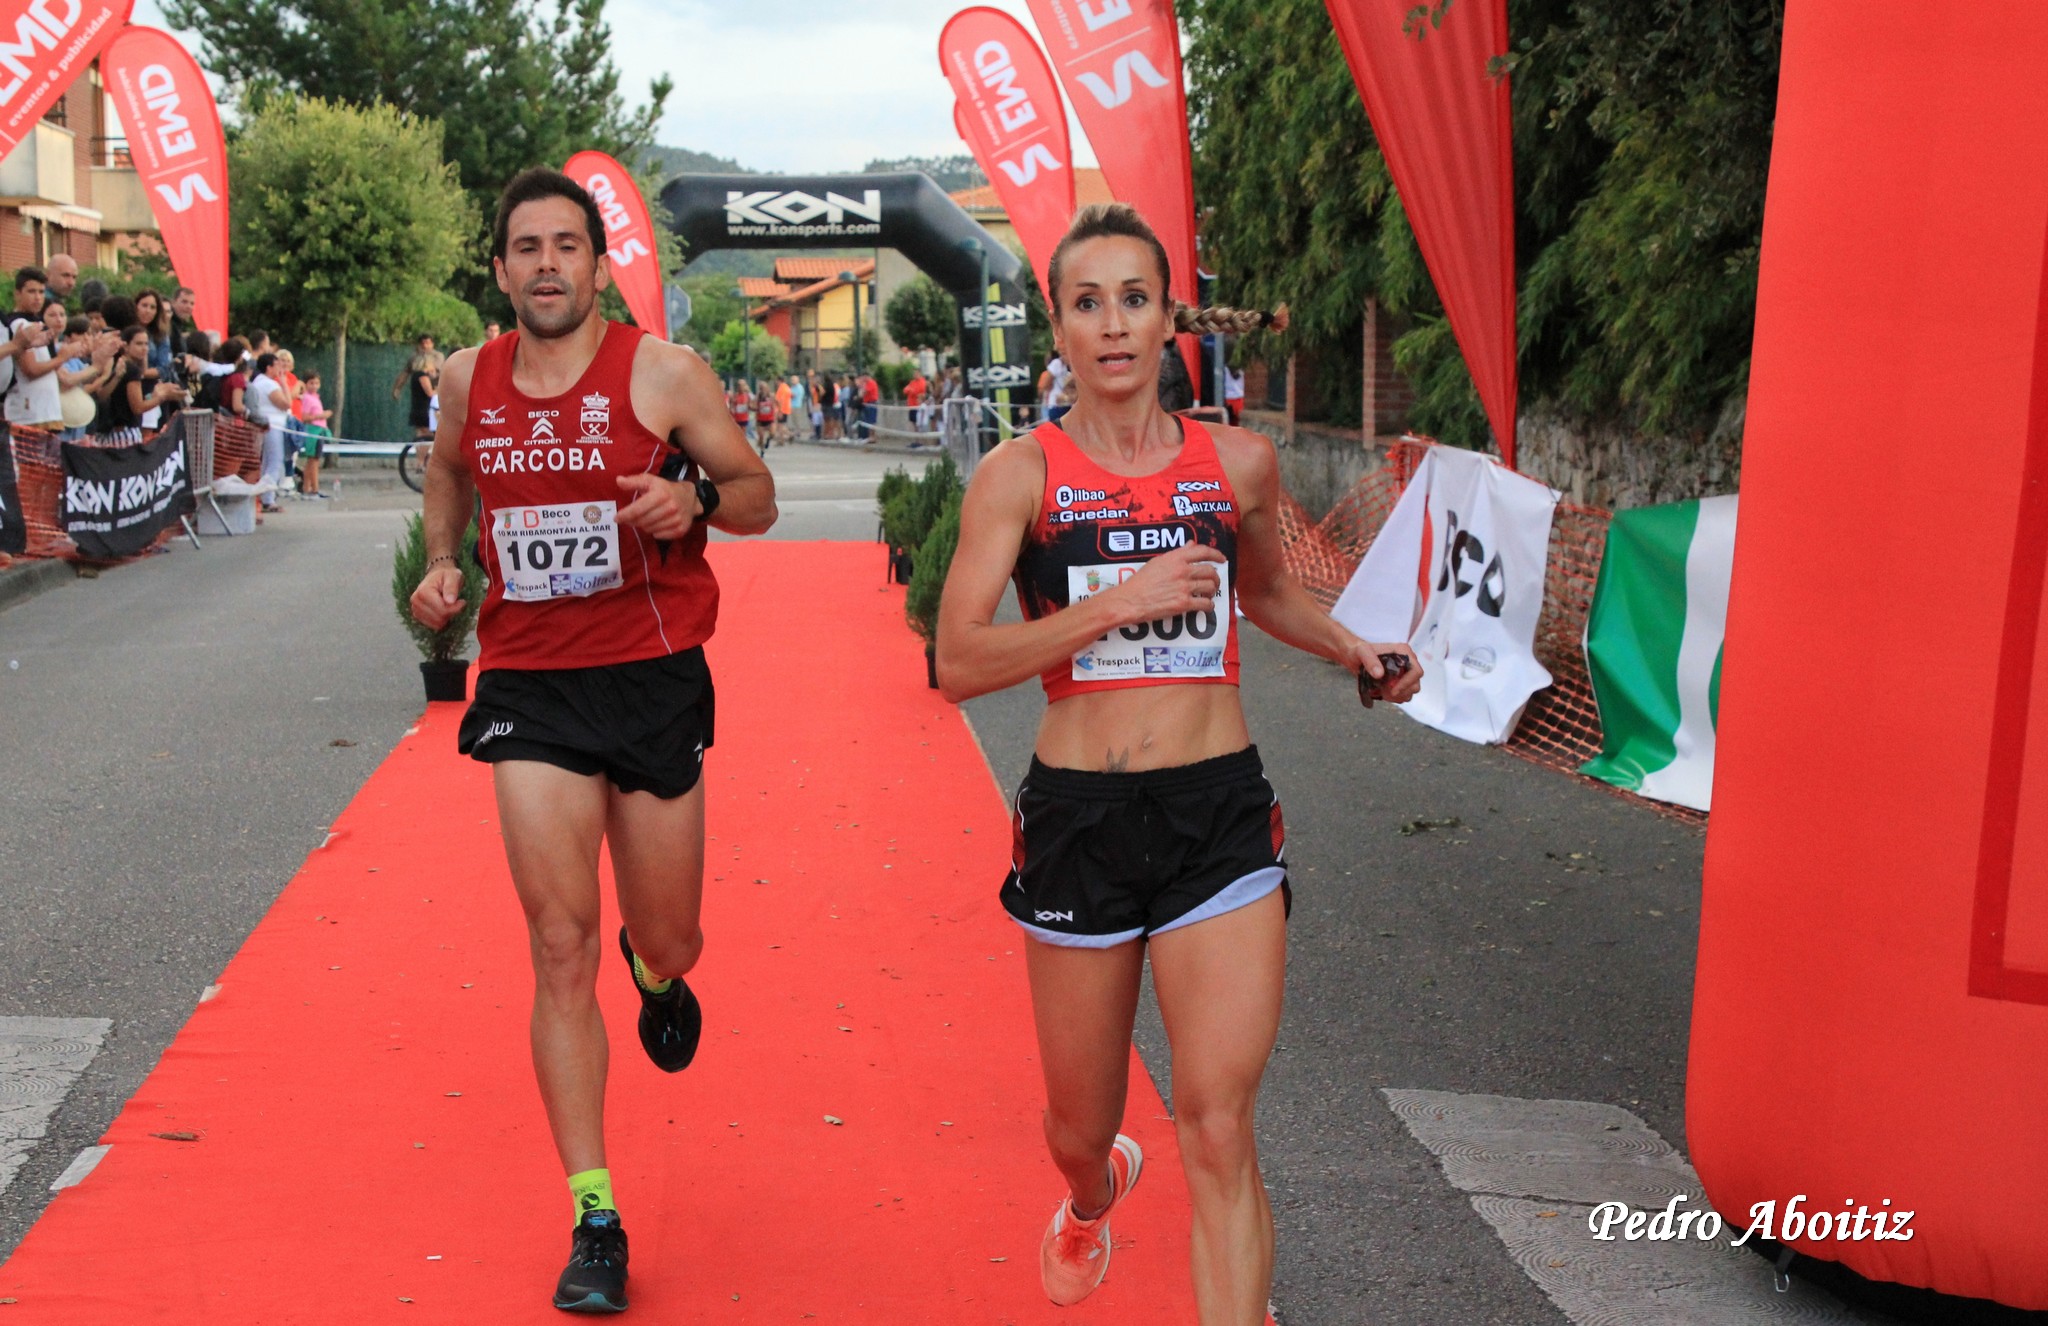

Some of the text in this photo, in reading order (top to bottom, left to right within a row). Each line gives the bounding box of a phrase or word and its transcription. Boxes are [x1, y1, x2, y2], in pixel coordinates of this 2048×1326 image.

[9, 7, 113, 127] eventos & publicidad
[723, 190, 881, 224] KON
[727, 222, 880, 237] www.konsports.com
[963, 303, 1026, 322] KON
[967, 365, 1030, 382] KON
[528, 410, 560, 418] BECO
[475, 437, 513, 449] LOREDO
[480, 448, 606, 474] CARCOBA
[1176, 481, 1220, 492] KON
[1057, 487, 1105, 505] Bilbao
[542, 510, 571, 519] Beco
[1192, 502, 1232, 512] BIZKAIA
[1060, 508, 1129, 523] Guedan
[520, 526, 577, 536] RIBAMONTÁN
[1140, 527, 1186, 550] BM
[507, 536, 608, 571] 1072
[515, 582, 548, 592] Trespack
[1097, 609, 1217, 641] 00
[1097, 656, 1141, 667] Trespack
